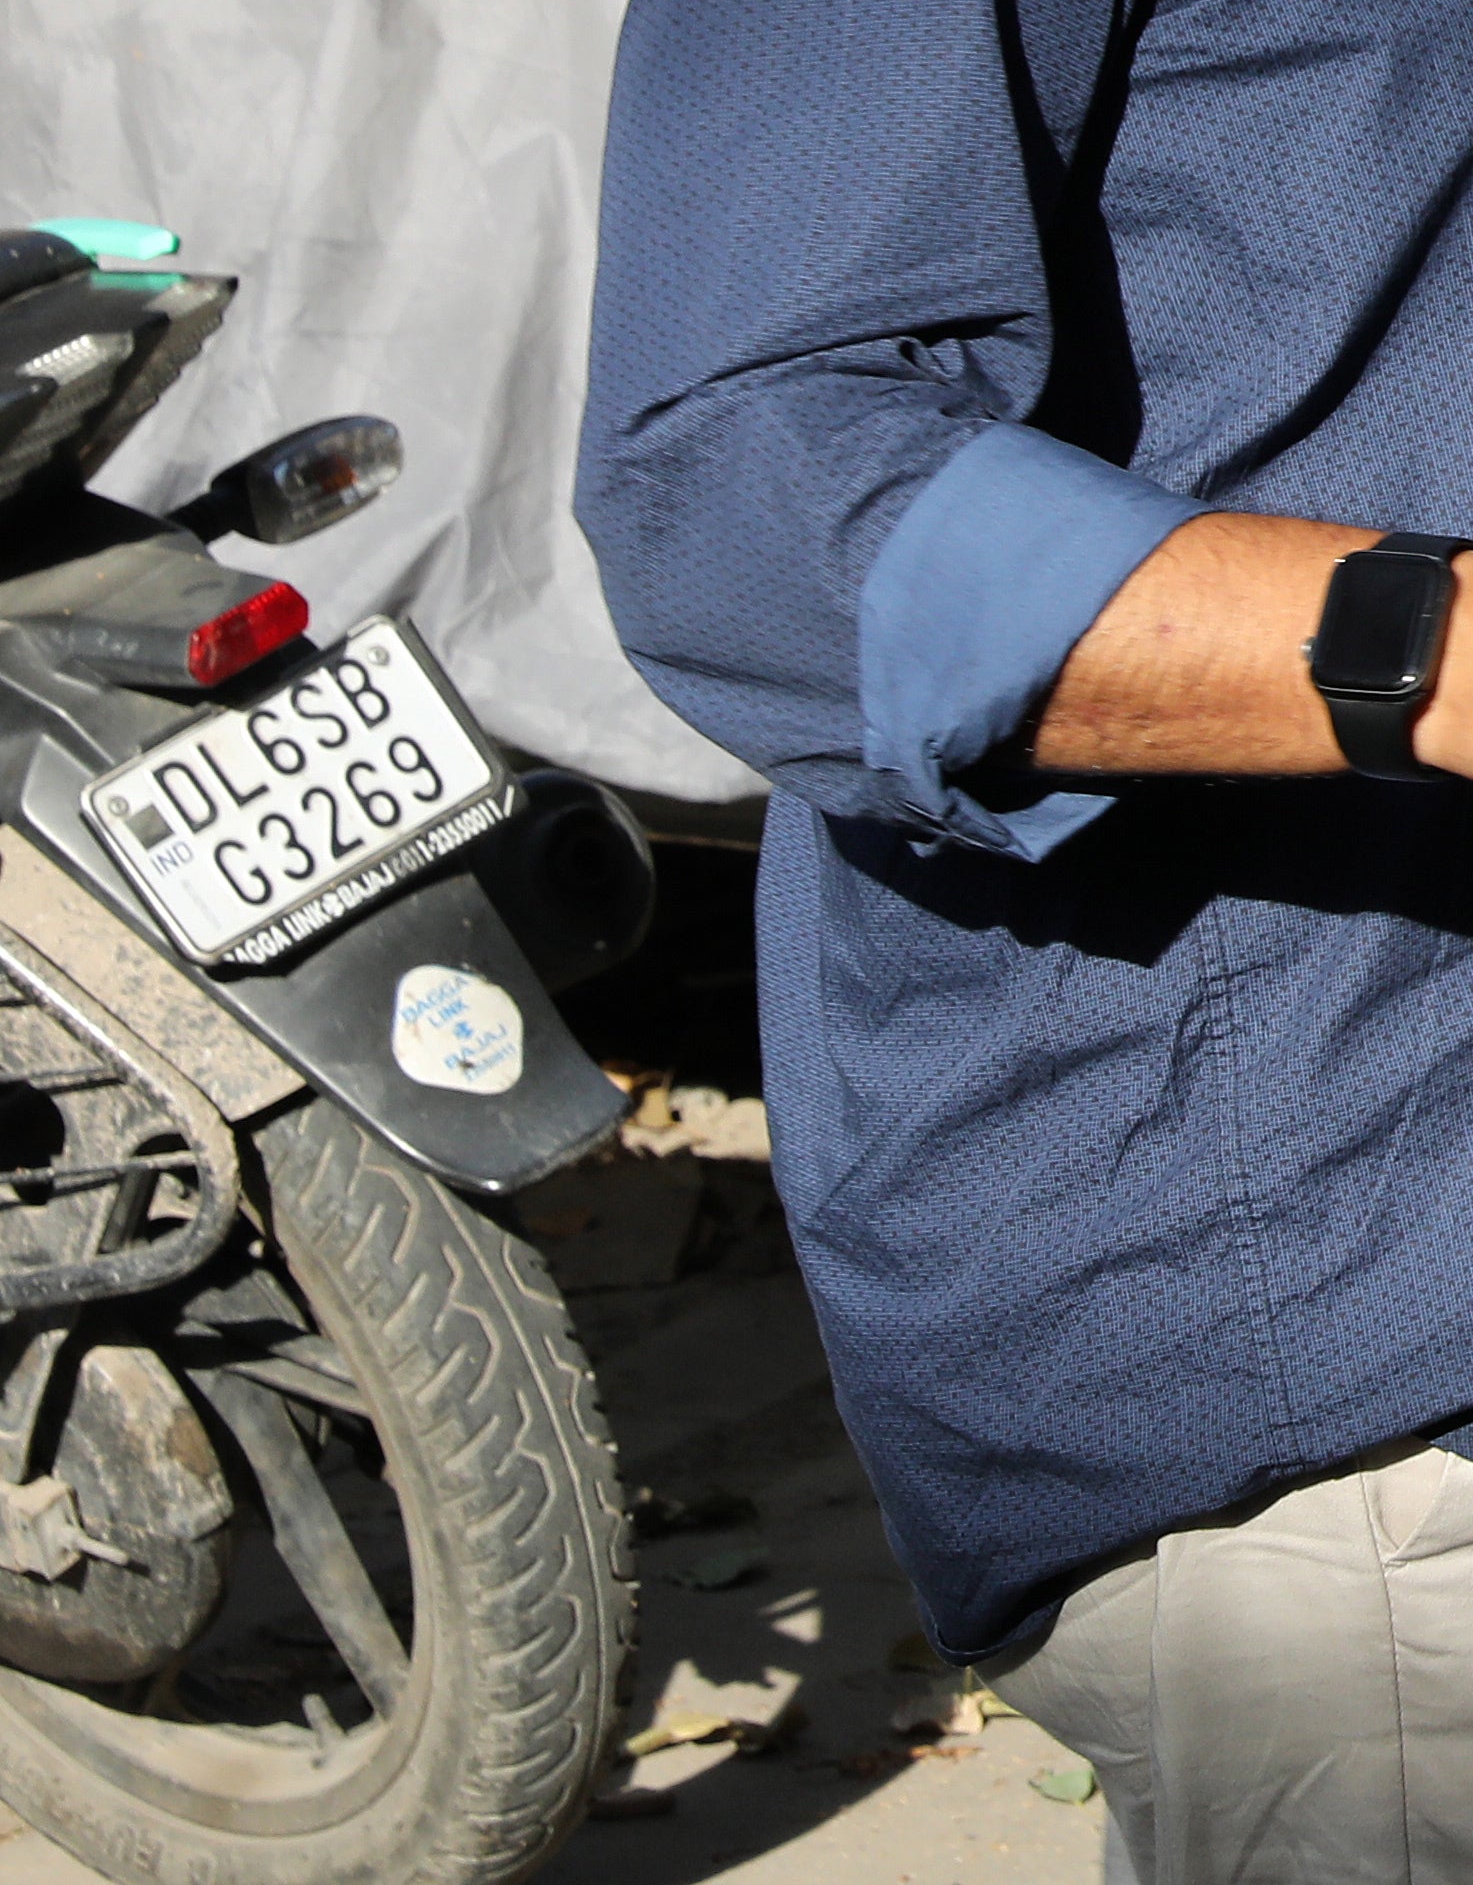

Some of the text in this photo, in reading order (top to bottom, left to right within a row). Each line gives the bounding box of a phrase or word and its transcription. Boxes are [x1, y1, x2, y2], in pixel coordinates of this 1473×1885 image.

[151, 658, 391, 834] DL6SB
[213, 736, 443, 906] G3269
[149, 841, 194, 878] IND
[282, 899, 330, 942] LINK
[339, 861, 397, 910] BAJAJ
[401, 976, 468, 1024] BAGGA
[428, 1000, 469, 1029] LINK
[445, 1023, 507, 1070] BAJAJ
